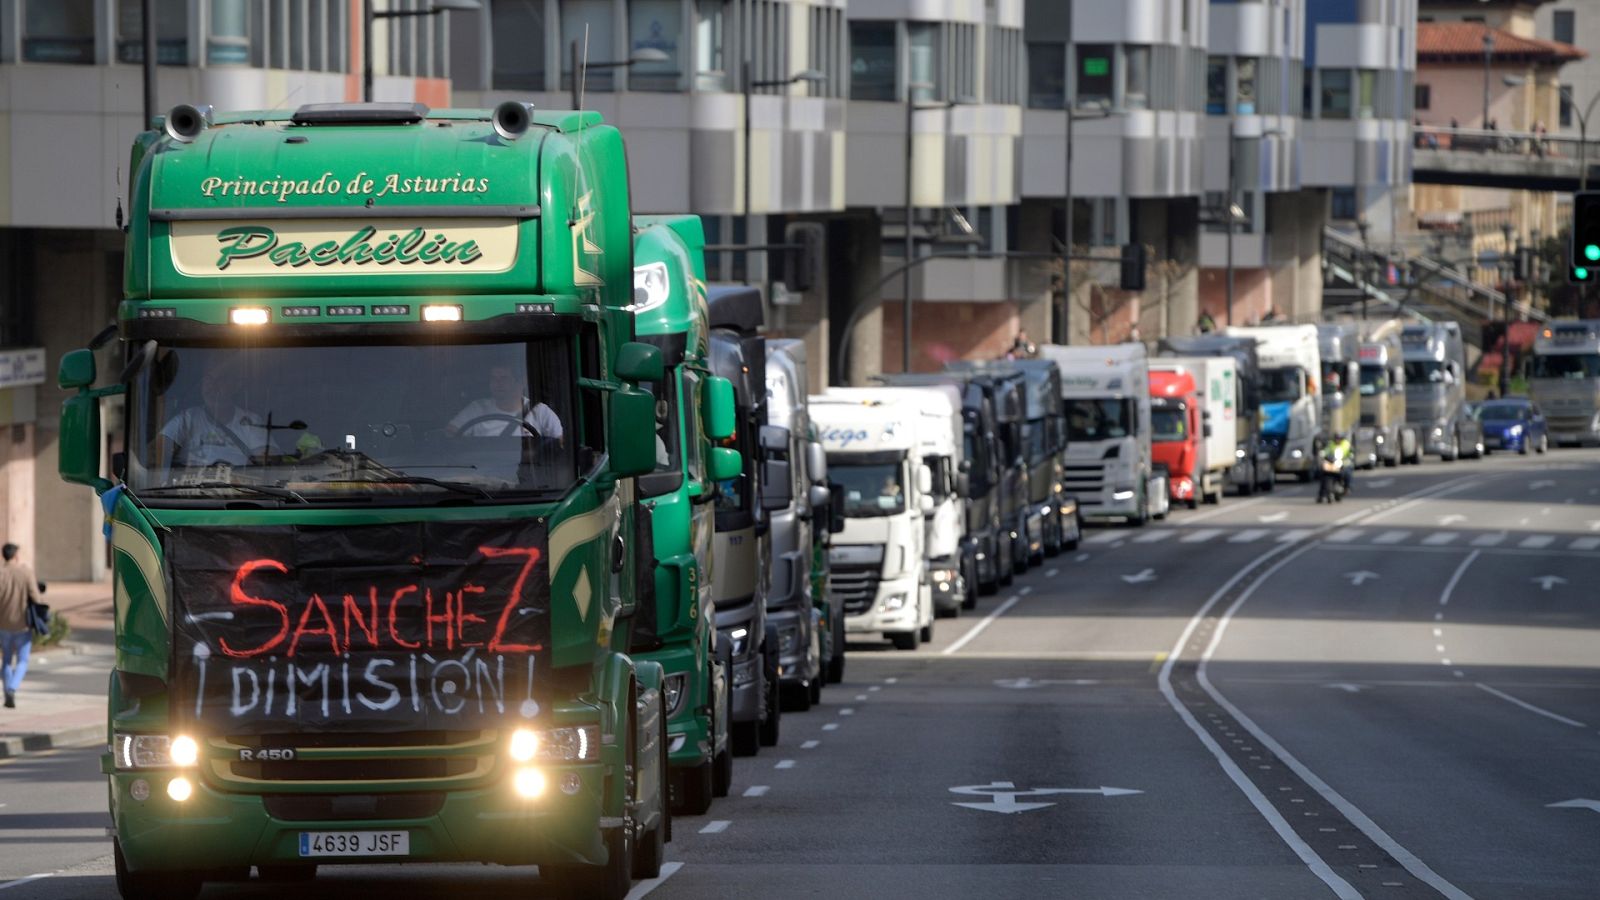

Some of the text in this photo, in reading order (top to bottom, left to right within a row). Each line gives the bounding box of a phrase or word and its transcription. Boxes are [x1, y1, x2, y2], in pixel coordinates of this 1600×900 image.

[201, 172, 489, 202] Principado de Asturias
[819, 424, 868, 447] iego
[218, 546, 543, 658] SANCHEZ
[239, 749, 294, 761] R 450
[313, 834, 401, 852] 4639 JSF
